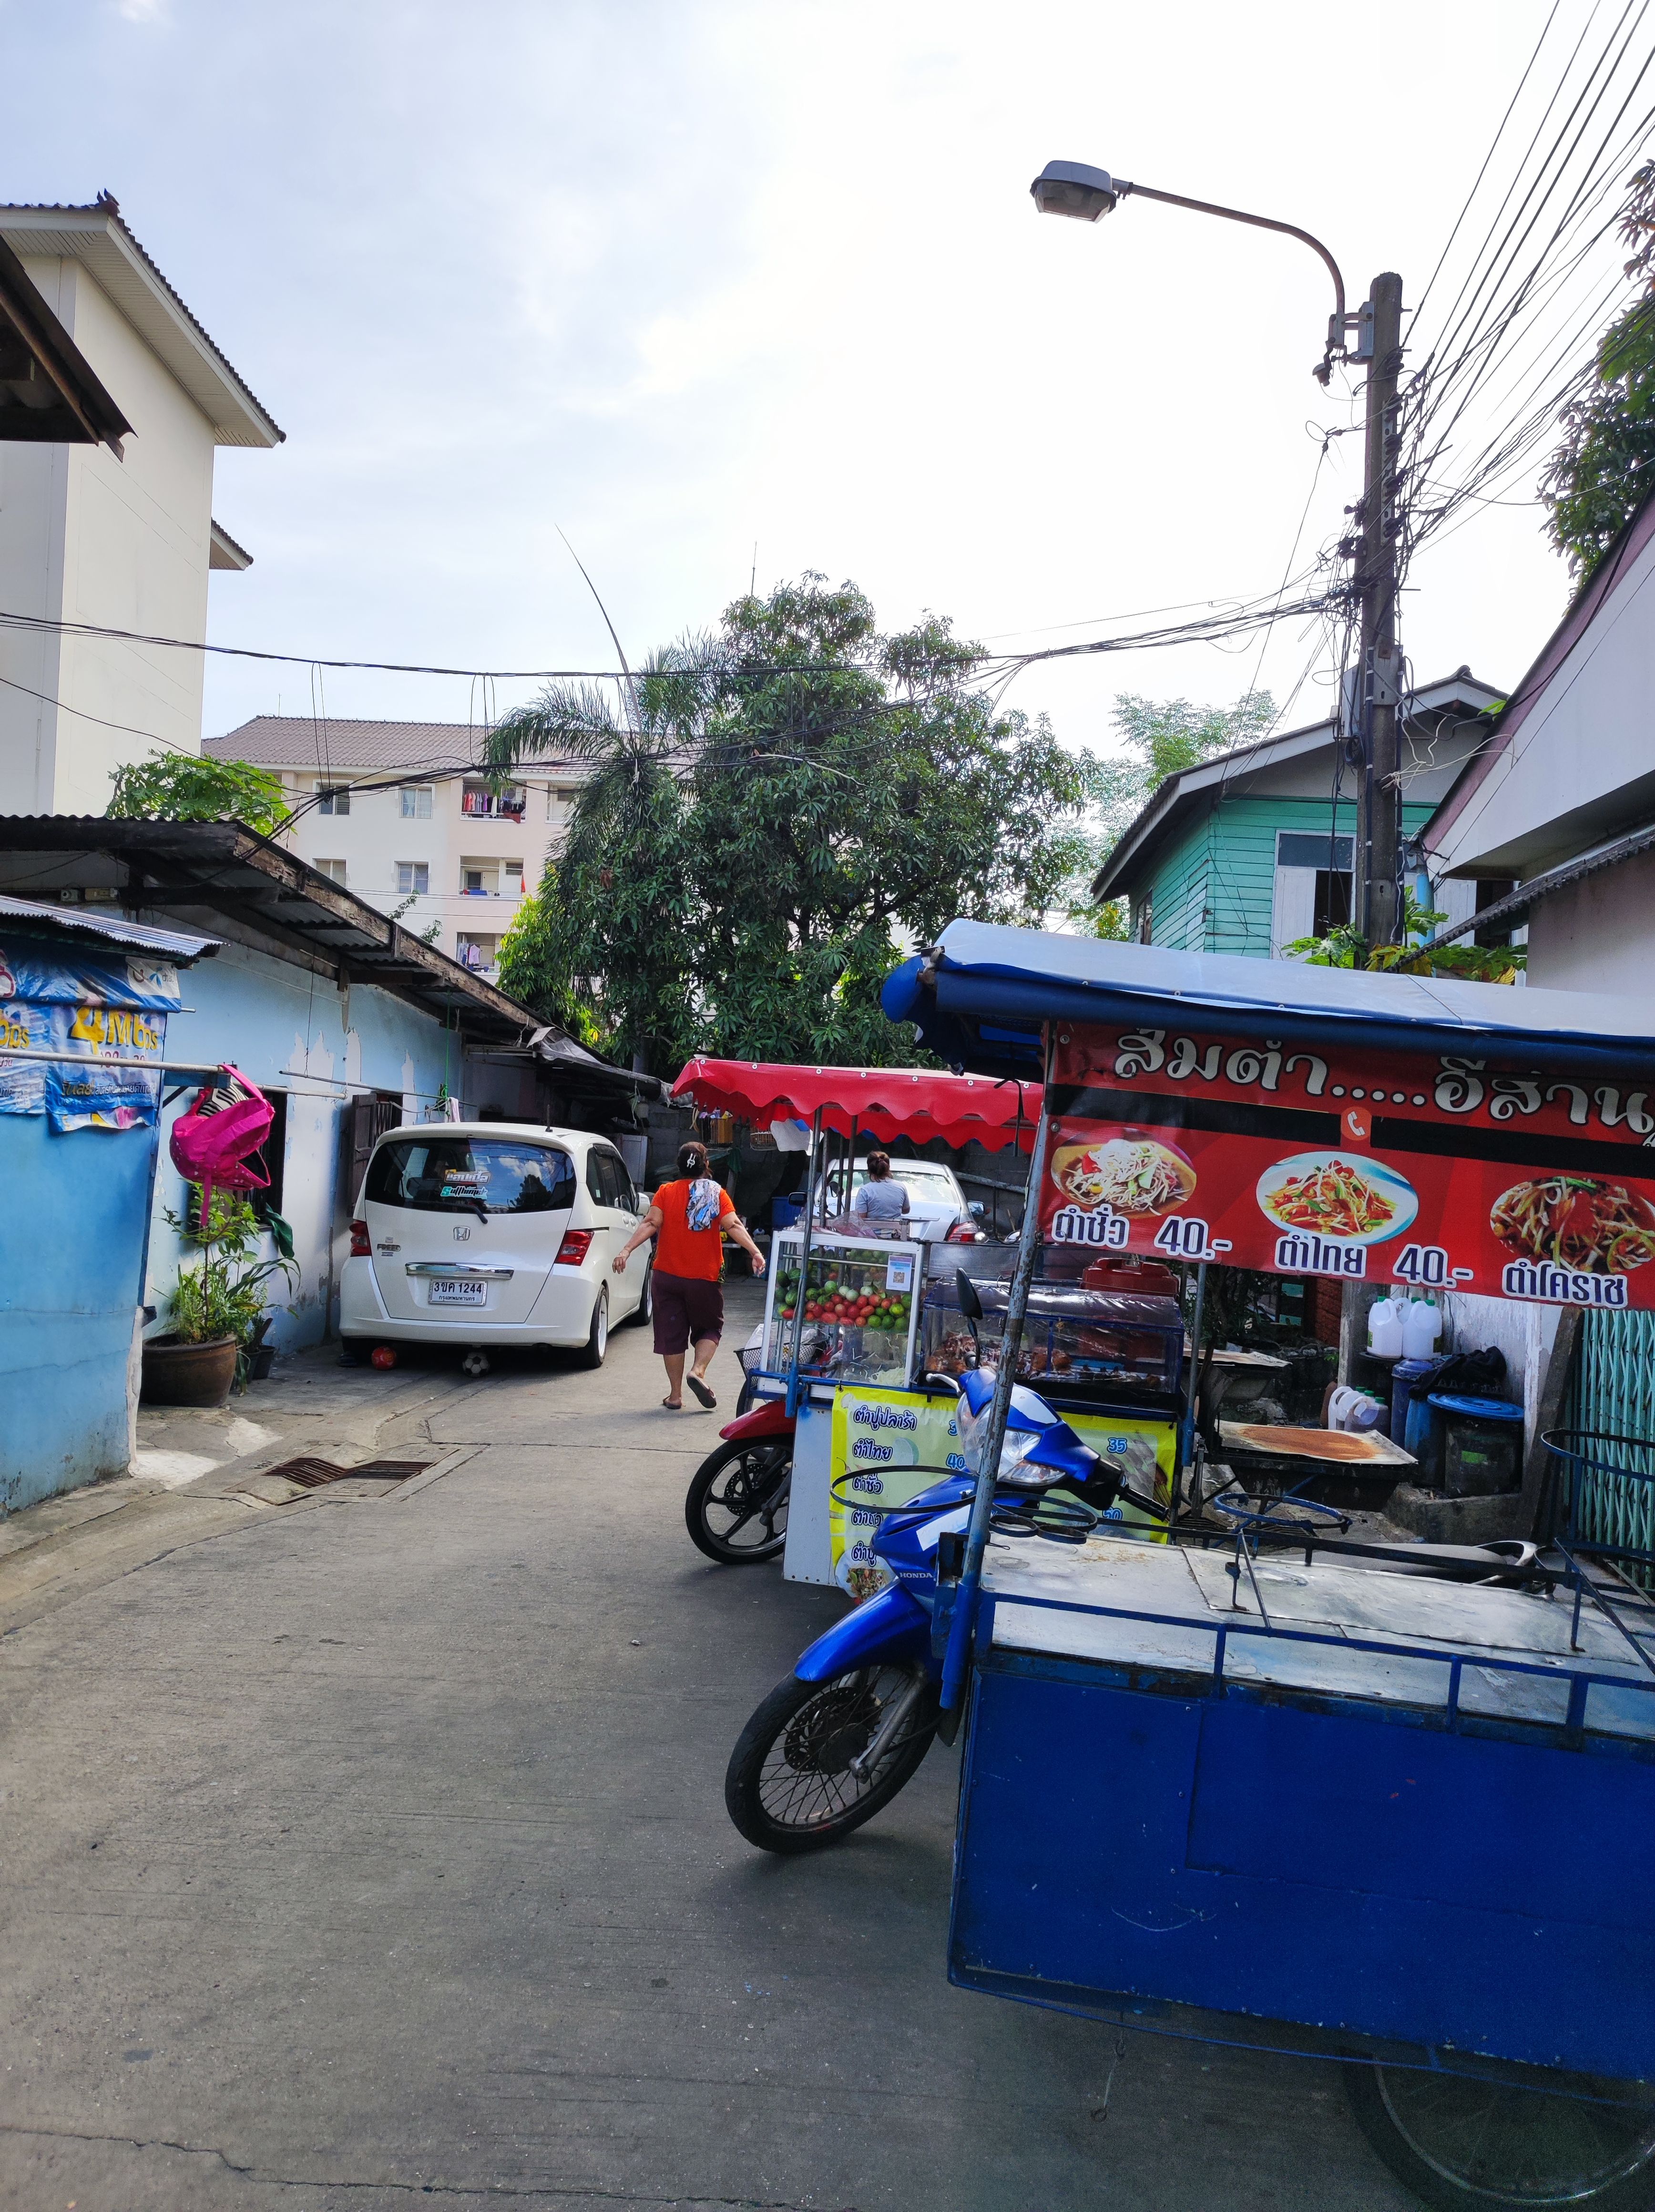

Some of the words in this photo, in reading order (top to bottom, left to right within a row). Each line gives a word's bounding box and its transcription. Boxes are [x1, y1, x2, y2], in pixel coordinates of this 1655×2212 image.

[1053, 1205, 1128, 1246] ตำซั่ว
[1156, 1218, 1230, 1258] 40.-
[1277, 1233, 1364, 1276] ตำไทย
[1395, 1246, 1471, 1286] 40.-
[434, 1282, 455, 1293] 3ขค
[459, 1283, 482, 1294] 1244
[1504, 1260, 1625, 1306] ตำโคราช
[854, 1405, 917, 1431] ตำปูปลาร้า
[852, 1438, 893, 1462] ตำไทย
[946, 1453, 966, 1470] 40
[1107, 1437, 1127, 1454] 35
